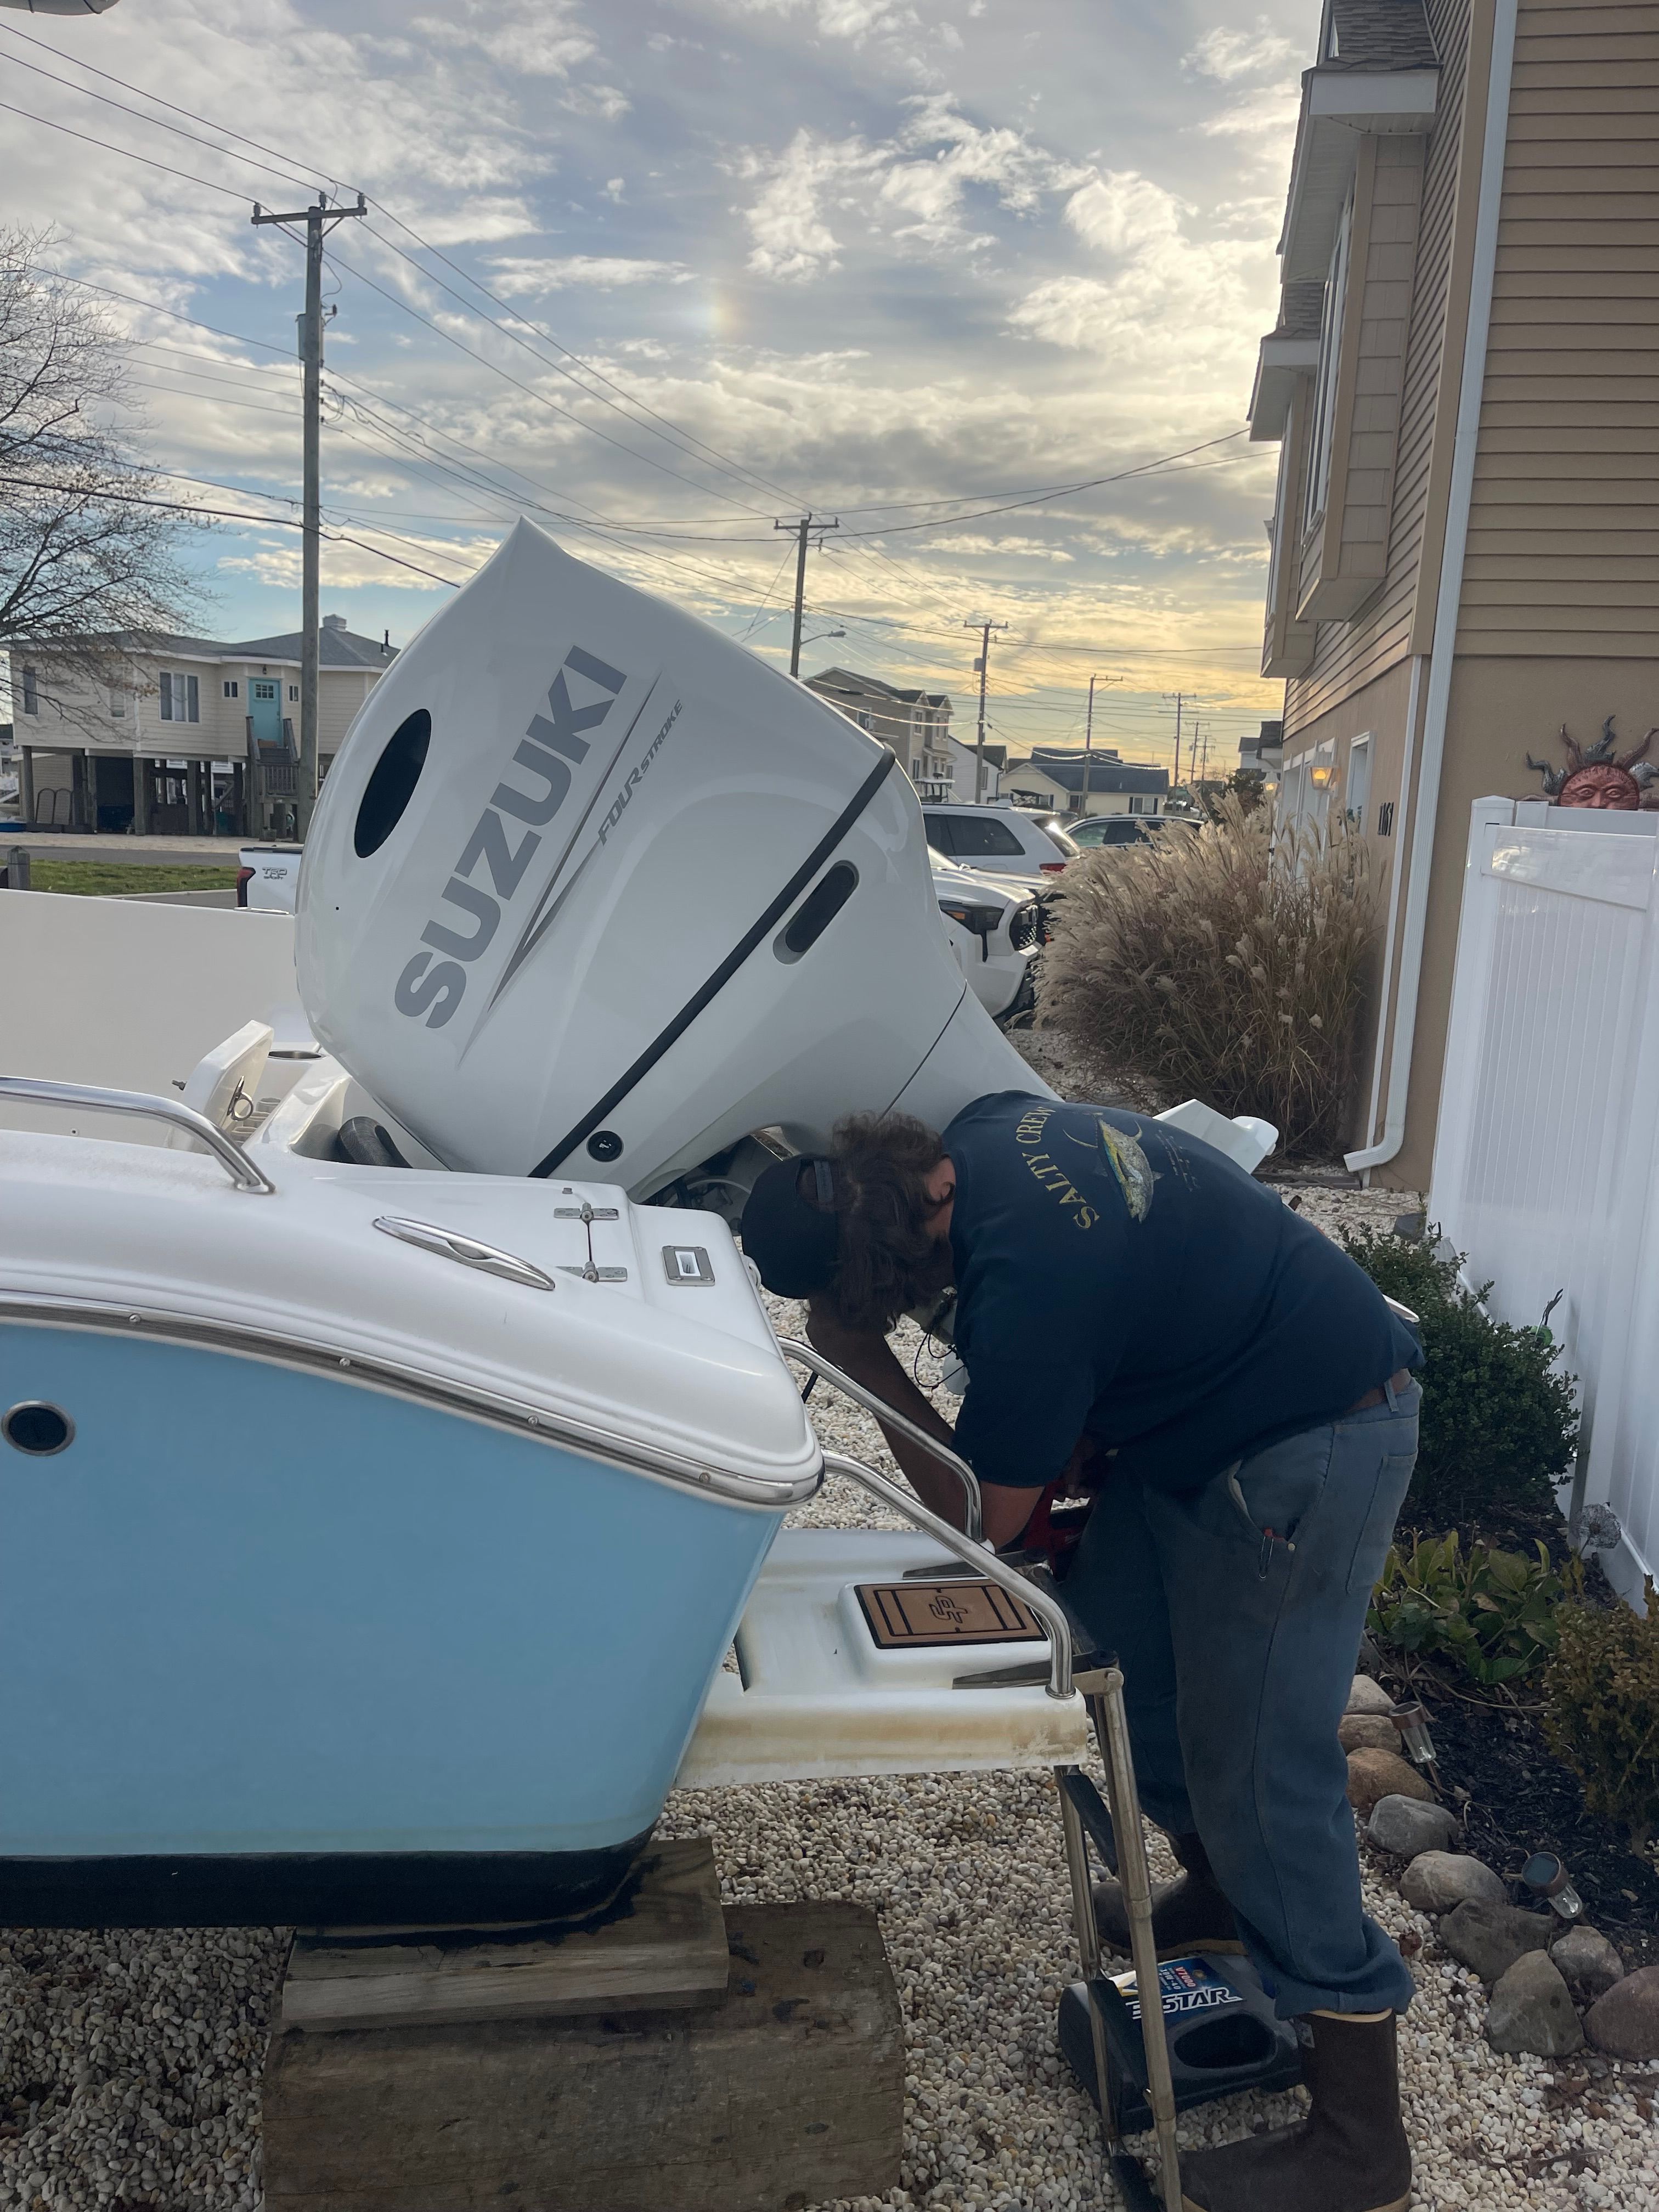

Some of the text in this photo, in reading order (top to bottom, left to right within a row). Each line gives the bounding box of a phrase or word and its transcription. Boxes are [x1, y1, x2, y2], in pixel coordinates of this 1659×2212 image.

[598, 699, 682, 845] FOUR STROKE
[262, 867, 287, 876] TRD
[394, 645, 627, 1028] SUZUKI
[1015, 1107, 1099, 1229] SALTY CREW
[1176, 1967, 1196, 1987] V7000
